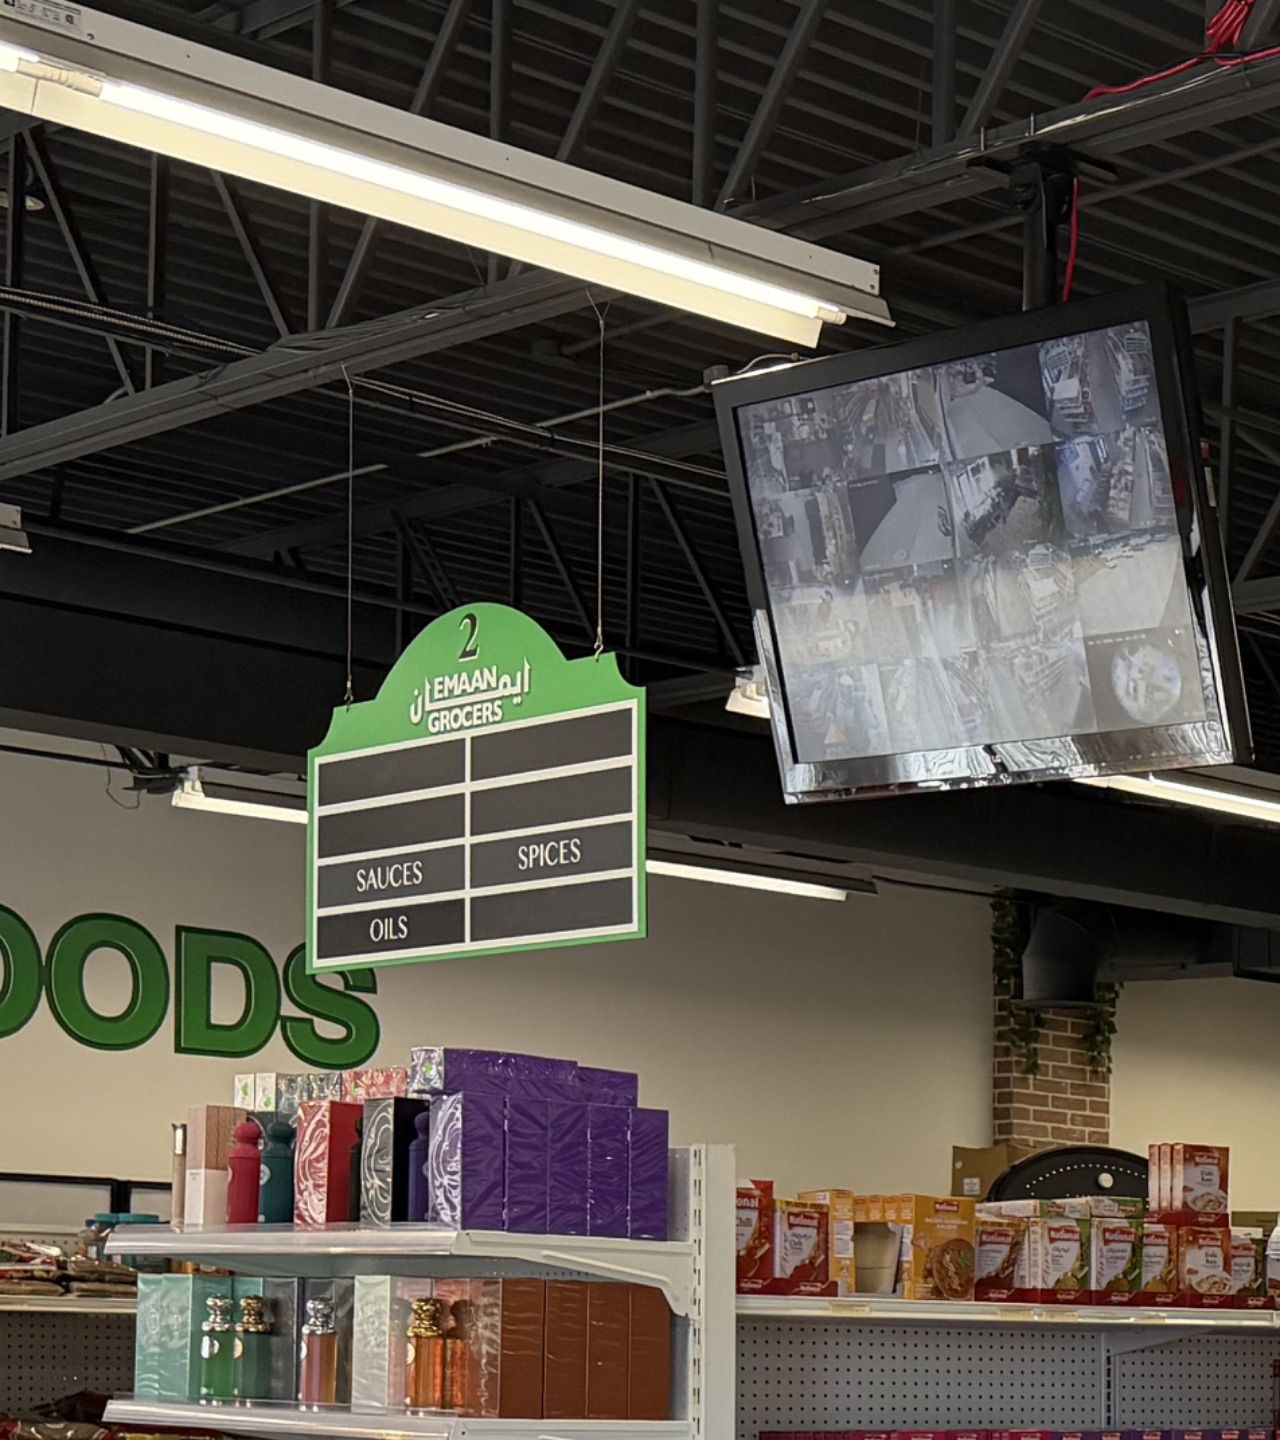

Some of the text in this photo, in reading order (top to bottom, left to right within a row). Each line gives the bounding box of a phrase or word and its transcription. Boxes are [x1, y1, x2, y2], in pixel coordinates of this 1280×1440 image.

[458, 613, 481, 661] 2
[433, 664, 498, 699] EMAAN
[427, 700, 503, 734] GROCERS
[518, 838, 581, 869] SPICES
[356, 861, 423, 892] SAUCES
[369, 916, 408, 942] OILS
